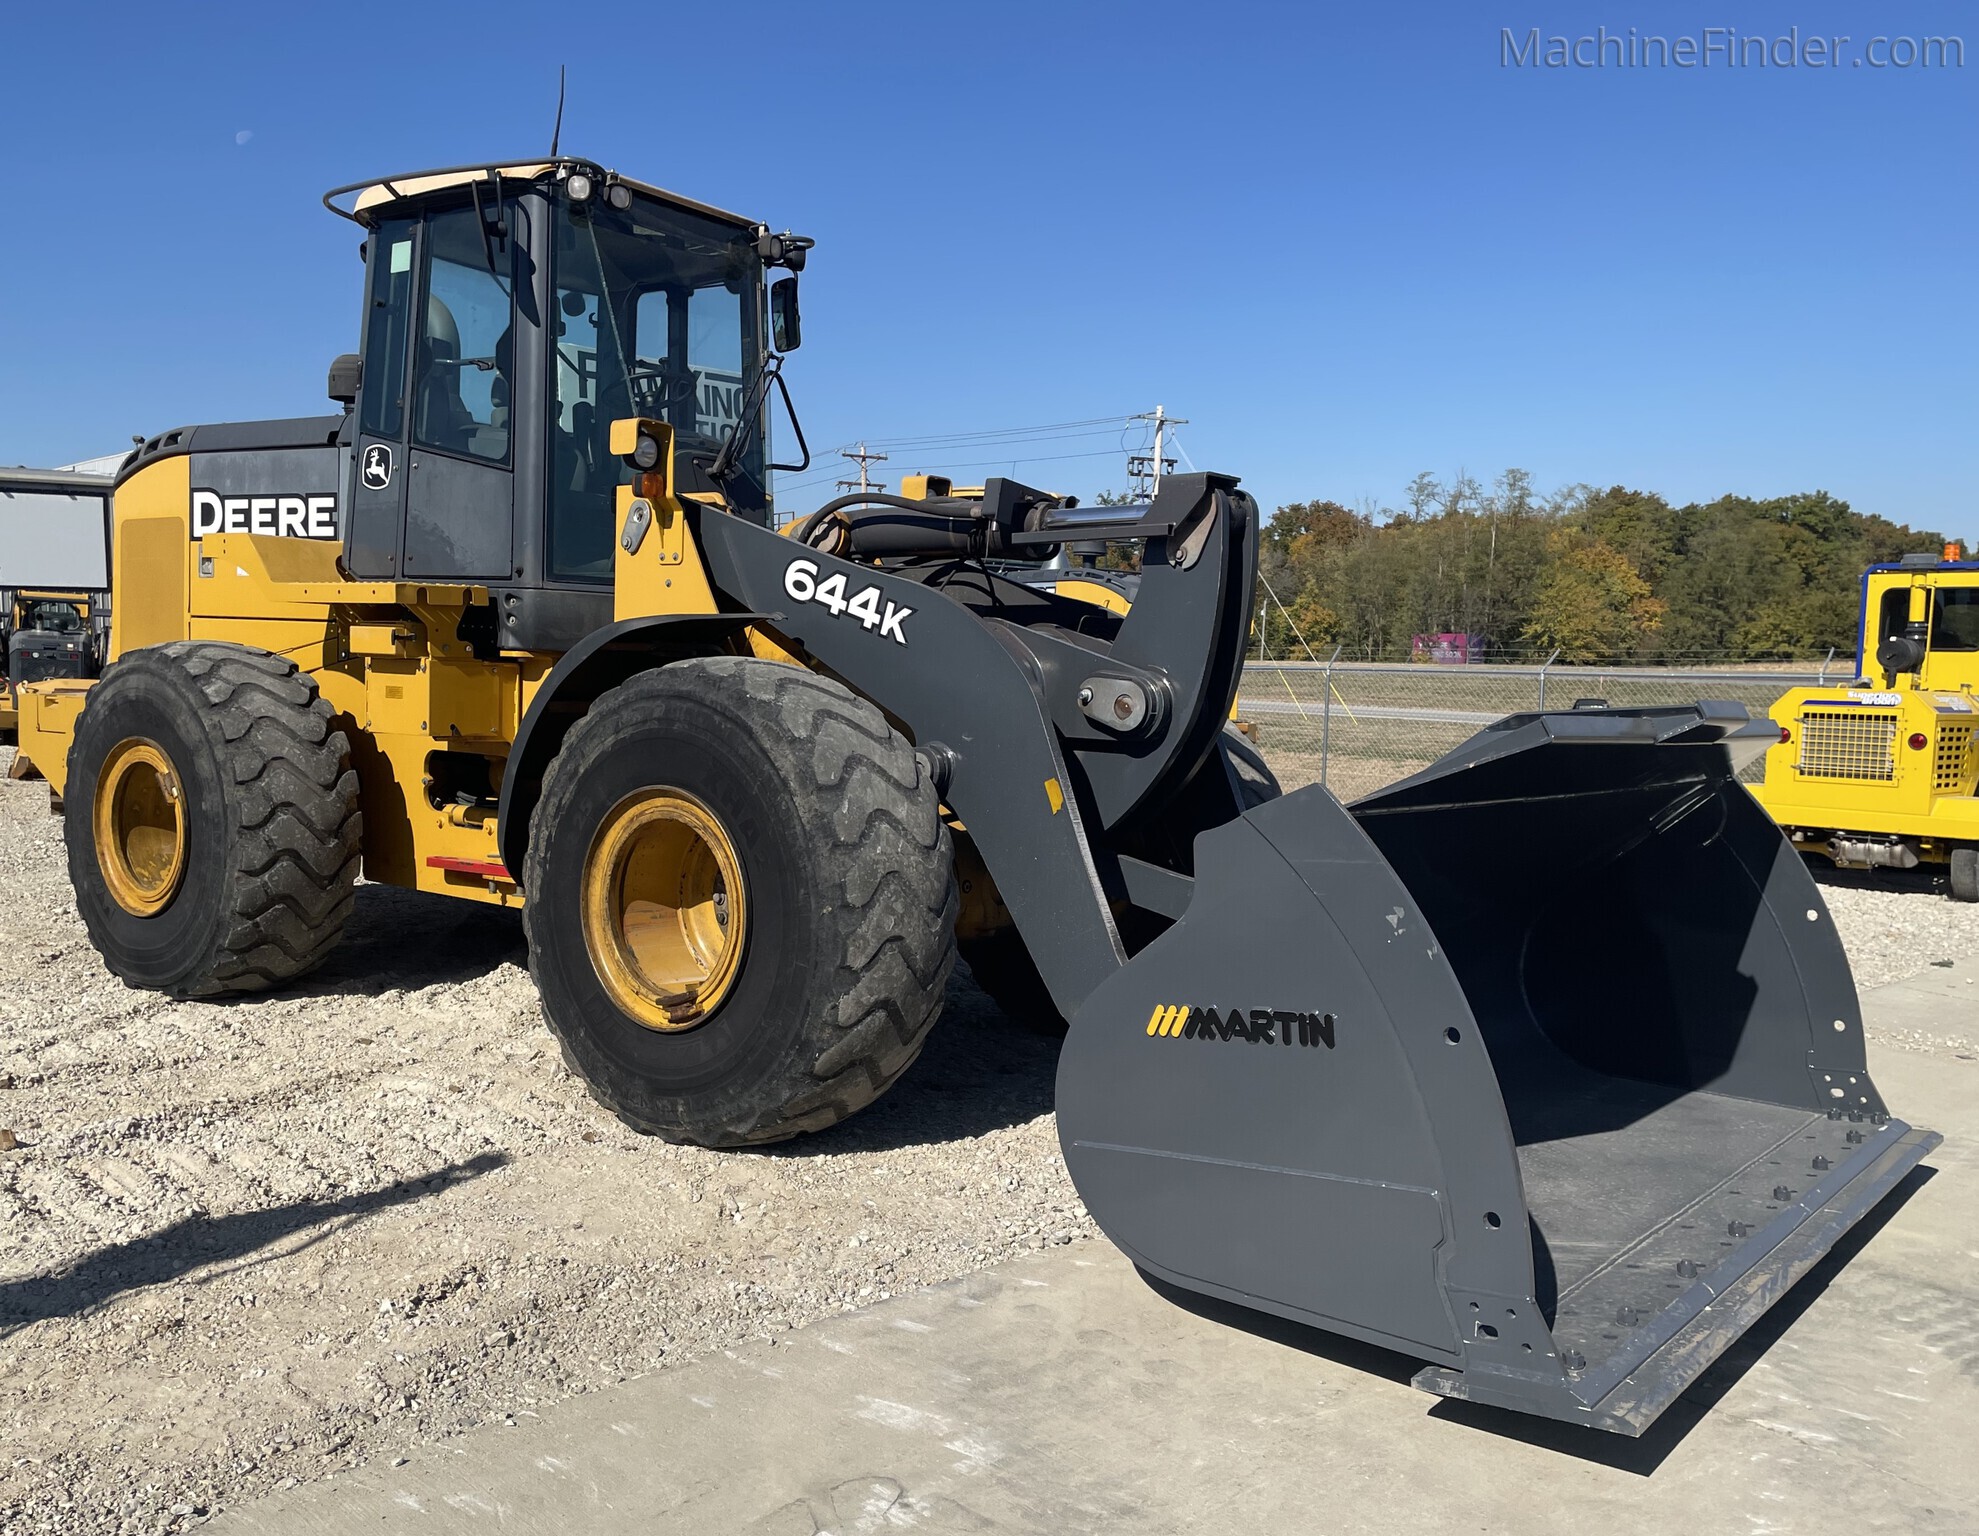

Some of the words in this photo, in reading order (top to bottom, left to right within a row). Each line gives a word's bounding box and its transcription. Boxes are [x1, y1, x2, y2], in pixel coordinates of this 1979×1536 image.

[192, 491, 335, 537] DEERE
[784, 559, 913, 644] 644K
[1184, 1006, 1336, 1050] MARTIN
